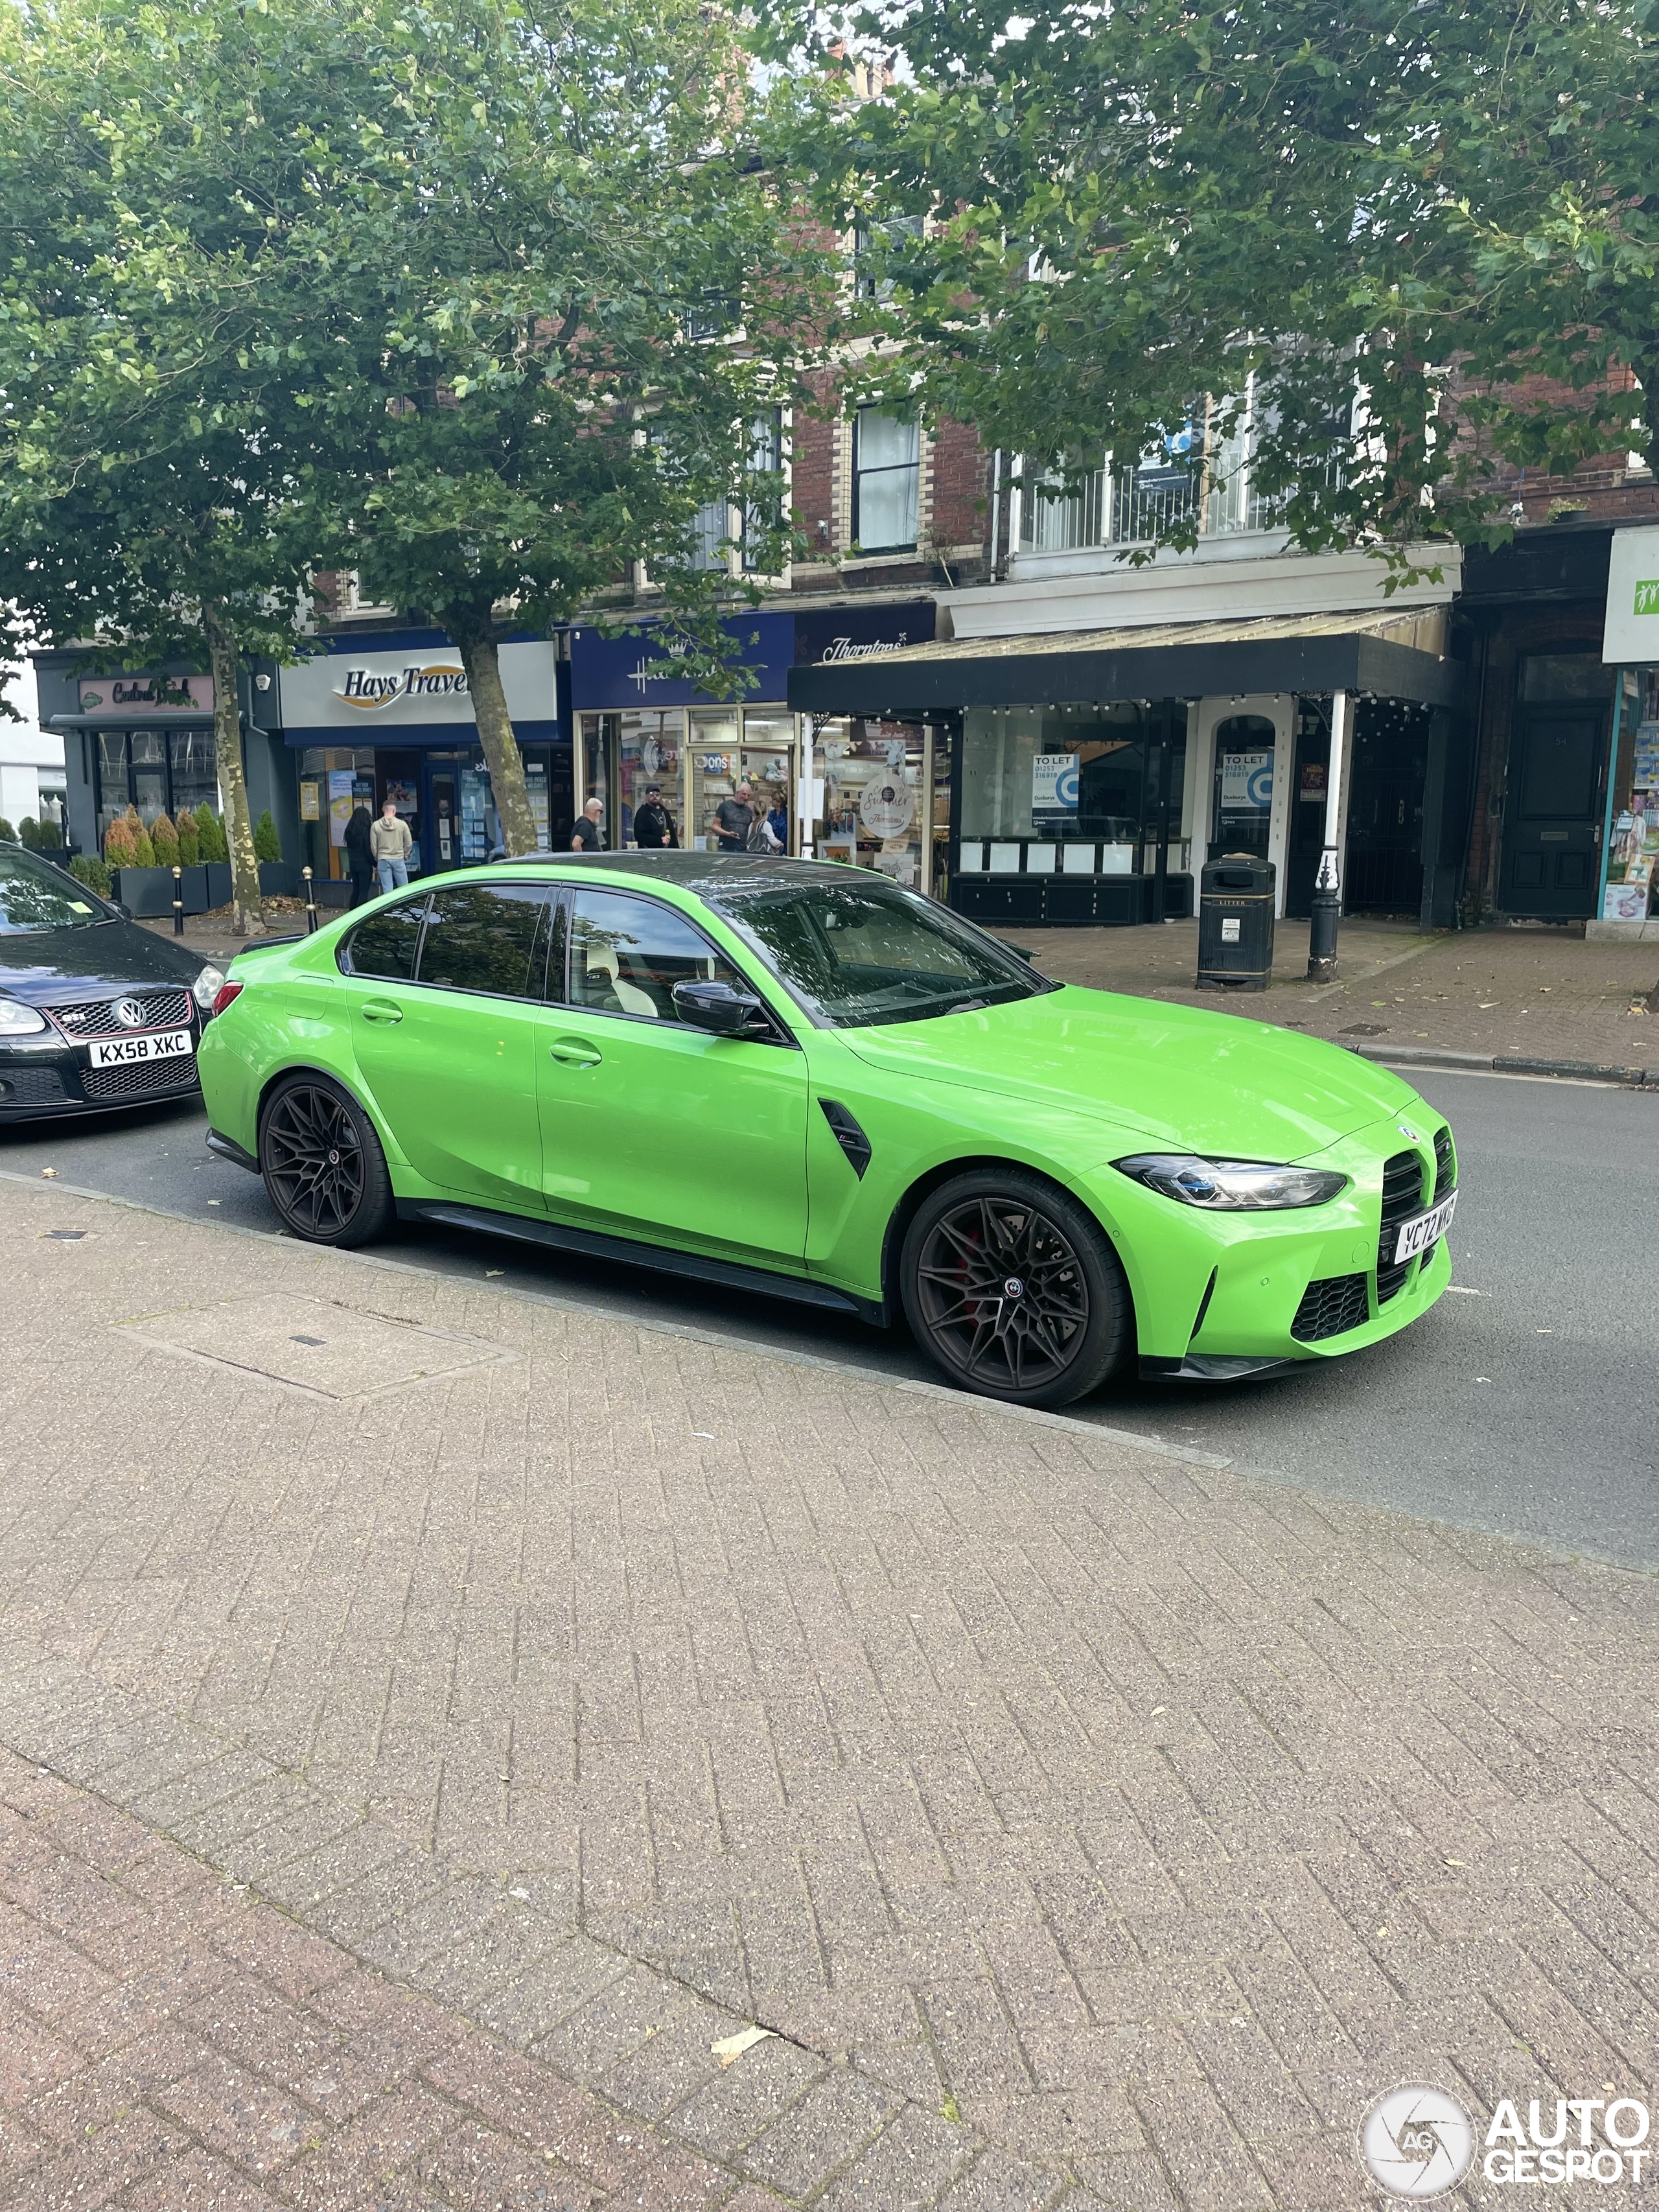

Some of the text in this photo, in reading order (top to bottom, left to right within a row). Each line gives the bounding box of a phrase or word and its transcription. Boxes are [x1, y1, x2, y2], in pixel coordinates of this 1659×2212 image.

[343, 668, 471, 703] Hays Trave
[1244, 756, 1264, 764] LET
[62, 1012, 86, 1022] GTI
[99, 1034, 185, 1063] KX58 XKC
[1404, 1213, 1437, 1255] YC72
